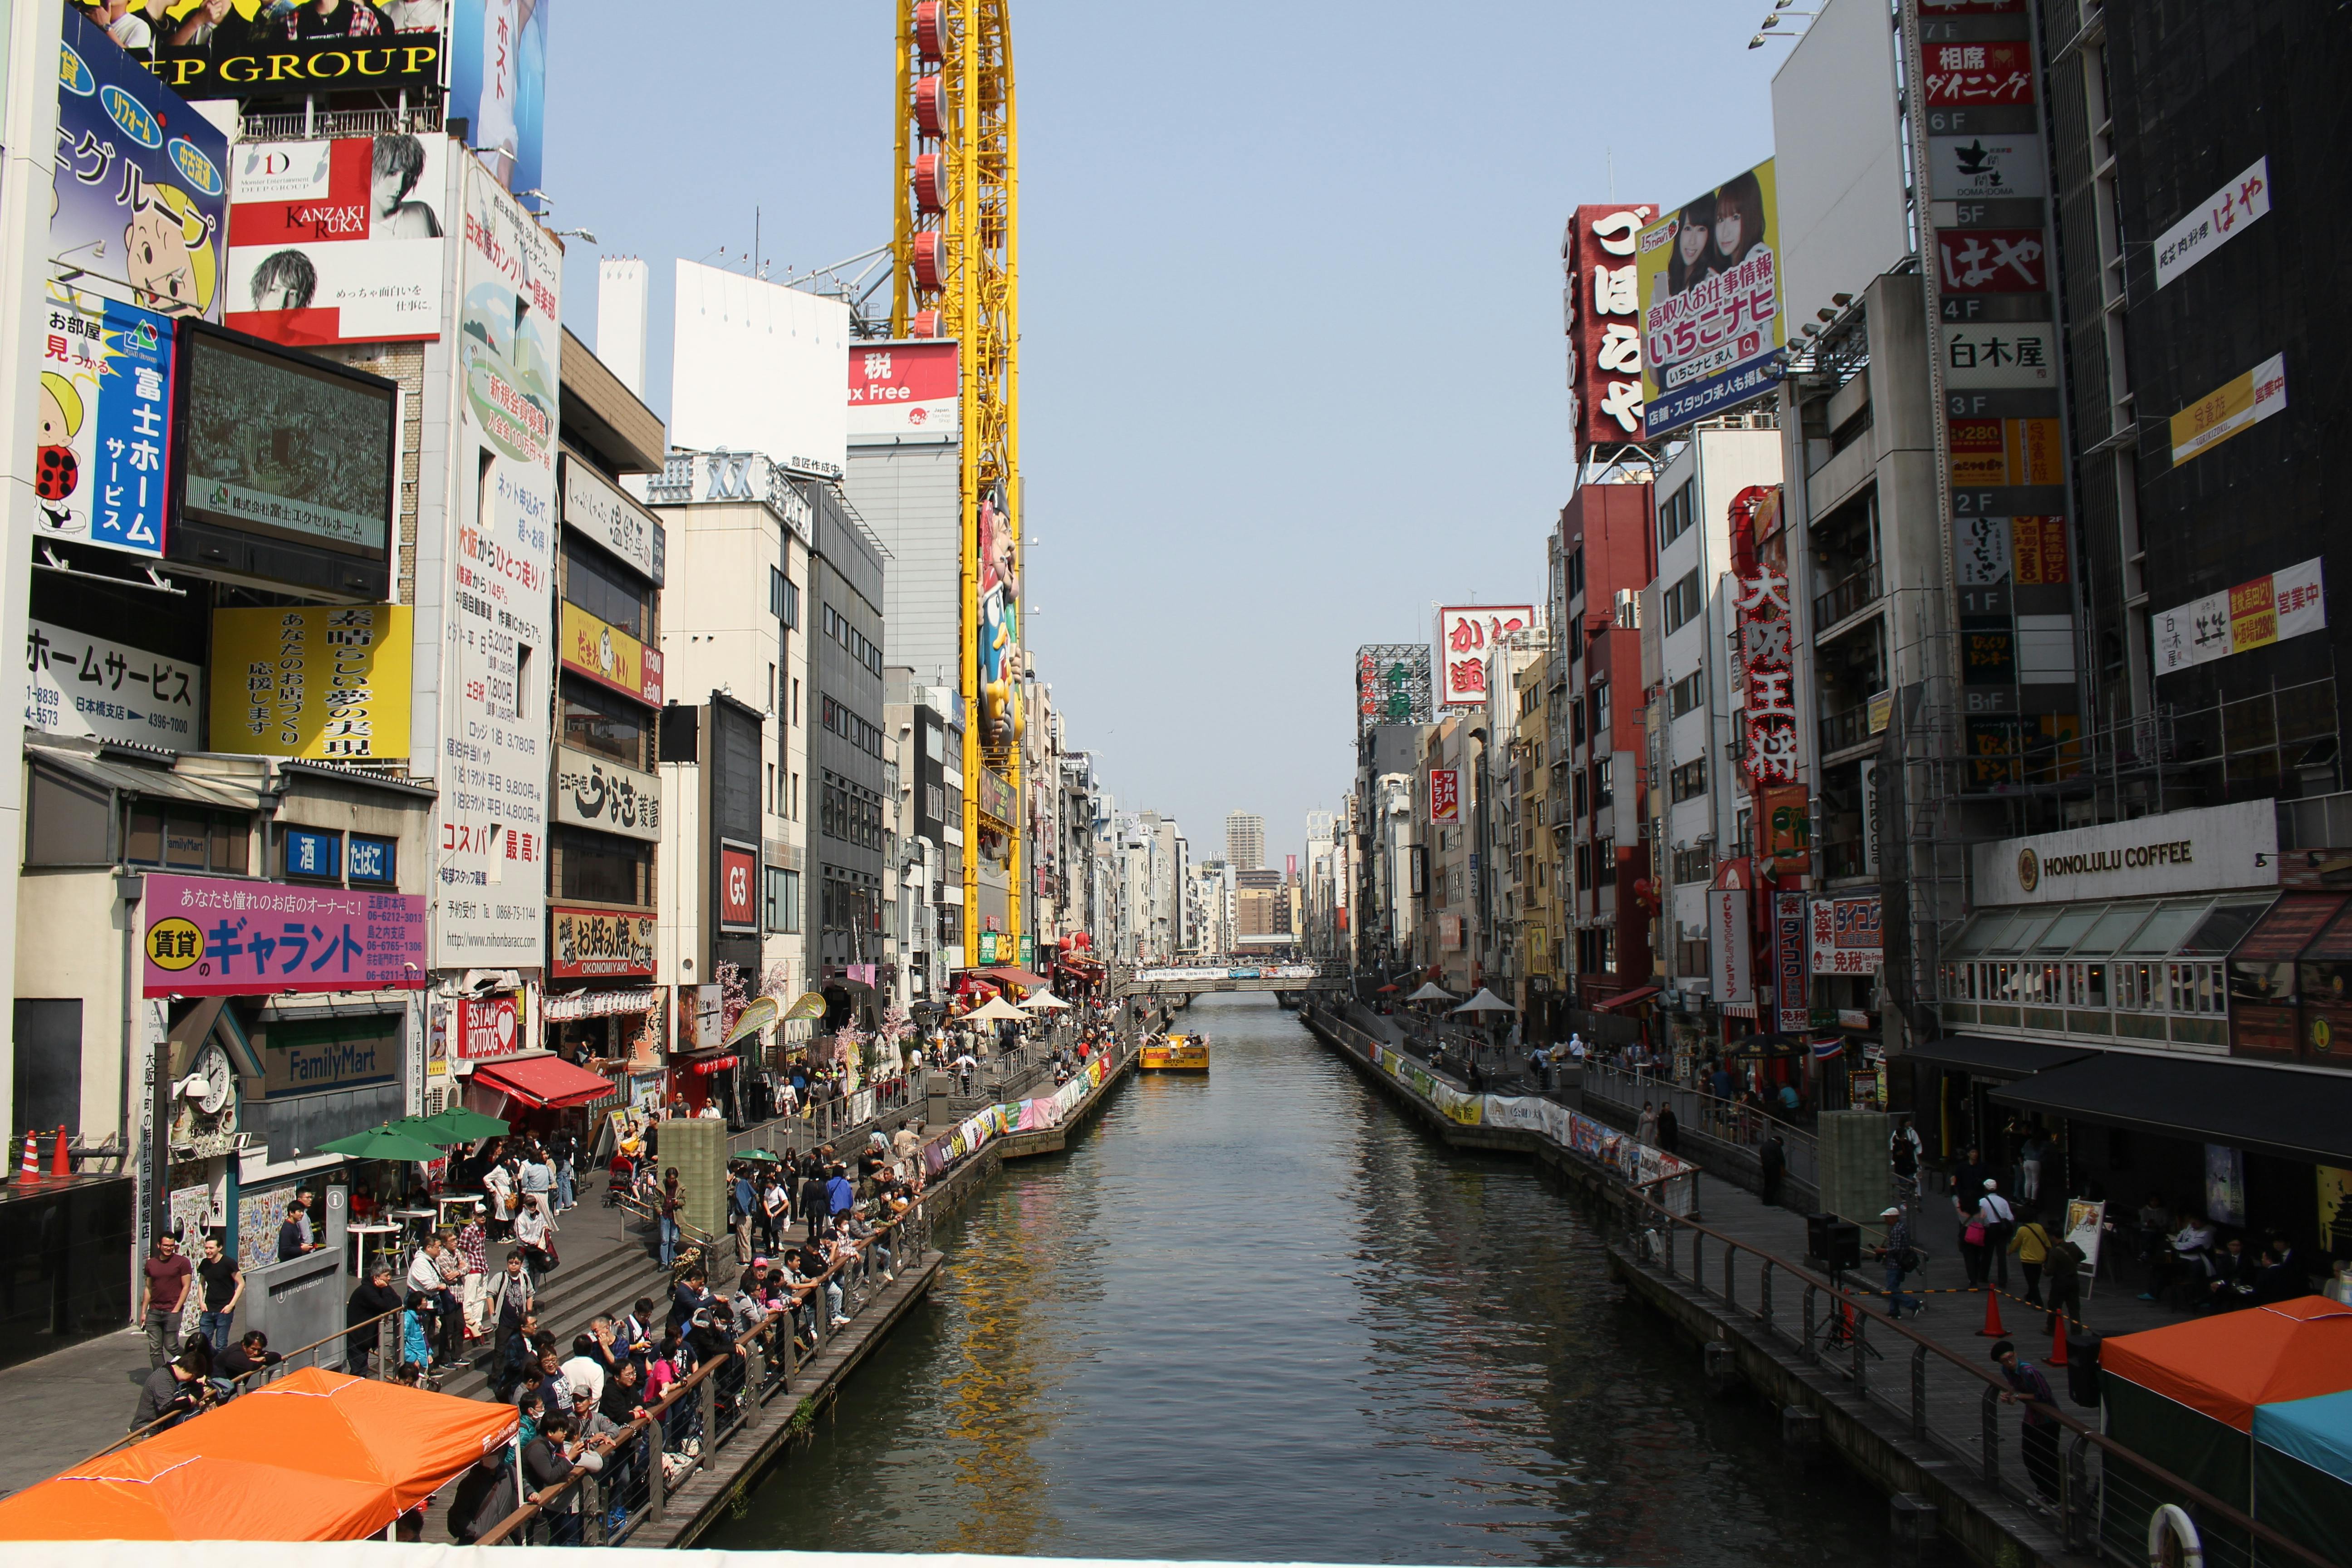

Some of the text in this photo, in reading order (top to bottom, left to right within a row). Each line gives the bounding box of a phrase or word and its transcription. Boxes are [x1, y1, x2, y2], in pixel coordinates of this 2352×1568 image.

[1925, 22, 1958, 39] 7F
[219, 46, 437, 82] GROUP
[497, 15, 510, 101] ホスト
[1939, 47, 1985, 71] 相席
[1926, 72, 2031, 101] ダイニング
[112, 91, 152, 144] リフォーム
[1931, 113, 1966, 131] 6F
[179, 147, 212, 191] 中古流通
[241, 176, 309, 186] Monster Entertainment
[241, 184, 309, 193] DEEP GROUP
[1957, 188, 2014, 196] DOMA-DOMA
[286, 204, 365, 228] KANZAKI
[1958, 206, 1984, 223] 5F
[2213, 176, 2263, 233] はや
[315, 218, 364, 239] RUKA
[466, 212, 556, 322] 日本原カンツリー倶楽部
[513, 231, 556, 283] チャンピオンコース
[1940, 237, 2043, 289] はや
[336, 284, 422, 300] めっちゃ面白いを
[396, 299, 432, 313] 仕事に。
[1646, 251, 1773, 332] 高収入お仕事情報
[1648, 279, 1775, 365] いちごナビ
[1945, 300, 1980, 318] 4F
[49, 311, 102, 342] お部屋
[44, 334, 109, 375] 見つかる
[1950, 333, 2047, 368] 白木屋
[864, 352, 892, 380] 税
[1669, 349, 1734, 383] いちごナビ 求人
[870, 384, 911, 400] Free
[1951, 396, 1986, 415] 3F
[2255, 376, 2284, 405] 営業中
[127, 366, 164, 545] 富士ホーム
[791, 456, 840, 473] 意匠作成中
[103, 436, 126, 531] サービス
[568, 477, 607, 524] しゃぶしゃぶ
[1957, 494, 1993, 512] 2F
[609, 504, 645, 563] 温野菜
[1965, 593, 1998, 611] 1F
[2230, 580, 2273, 615] 豊後高田どり
[2278, 582, 2319, 616] 営業中
[488, 628, 514, 659] 5,200円
[2166, 614, 2181, 667] 白木屋
[27, 628, 192, 707] ホームサービス
[645, 649, 661, 675] 17:00
[1732, 562, 1798, 783] 大阪王将
[279, 613, 305, 745] あなたのお店づくり
[323, 608, 374, 758] 素晴らしい夢の実現
[466, 679, 485, 703] 土日祝
[486, 675, 513, 705] 7,800円
[1361, 654, 1377, 715] お好み焼
[75, 696, 125, 720] 日本橋支店
[247, 661, 274, 736] 応援します
[148, 712, 188, 734] 4396-7000
[469, 721, 535, 756] ロッジ 1泊 3,780円
[488, 773, 502, 793] 平日
[560, 772, 589, 796] 江戸焼
[575, 763, 637, 828] うなぎ
[1434, 778, 1444, 811] ドラッグ
[1444, 773, 1455, 803] ツルハ
[638, 794, 659, 829] 菱富
[167, 836, 204, 853] FamilyMart
[300, 836, 315, 871] 酒
[444, 823, 488, 856] コスパ
[350, 844, 382, 876] たばこ
[2043, 839, 2193, 877] HONOLULU COFFEE
[442, 867, 488, 887] 幹部スタッフ募集
[729, 865, 746, 906] G3
[368, 911, 423, 923] 06-6212-3013
[447, 900, 536, 921] 予約受付 0868-75-1144
[1780, 896, 1800, 915] 薬
[154, 929, 197, 959] 賃貸
[206, 916, 363, 976] ギャラント
[367, 926, 406, 941] 島之内支店
[367, 941, 422, 951] 06-6765-1306
[447, 931, 537, 949] http://www.nihonbaracc.com
[577, 914, 630, 958] お好み焼
[982, 936, 995, 950] 薬
[1020, 938, 1031, 950] 薬
[1780, 917, 1804, 976] ダイコク
[366, 953, 406, 967] 宗右衛門町支店
[563, 941, 577, 970] 大阪
[581, 961, 627, 975] OKONOMIYAKI
[630, 937, 652, 972] たこ焼
[1833, 951, 1863, 972] 免税
[199, 962, 211, 978] の
[366, 970, 422, 981] 06-6211-2727
[468, 1003, 496, 1028] 5STAR
[647, 1000, 665, 1055] お好み焼
[1780, 1008, 1808, 1022] 免税
[468, 1026, 498, 1054] HOTDOG
[289, 1044, 376, 1082] FamilyMart
[141, 1179, 152, 1240] 道頓堀店
[288, 1275, 324, 1296] information
